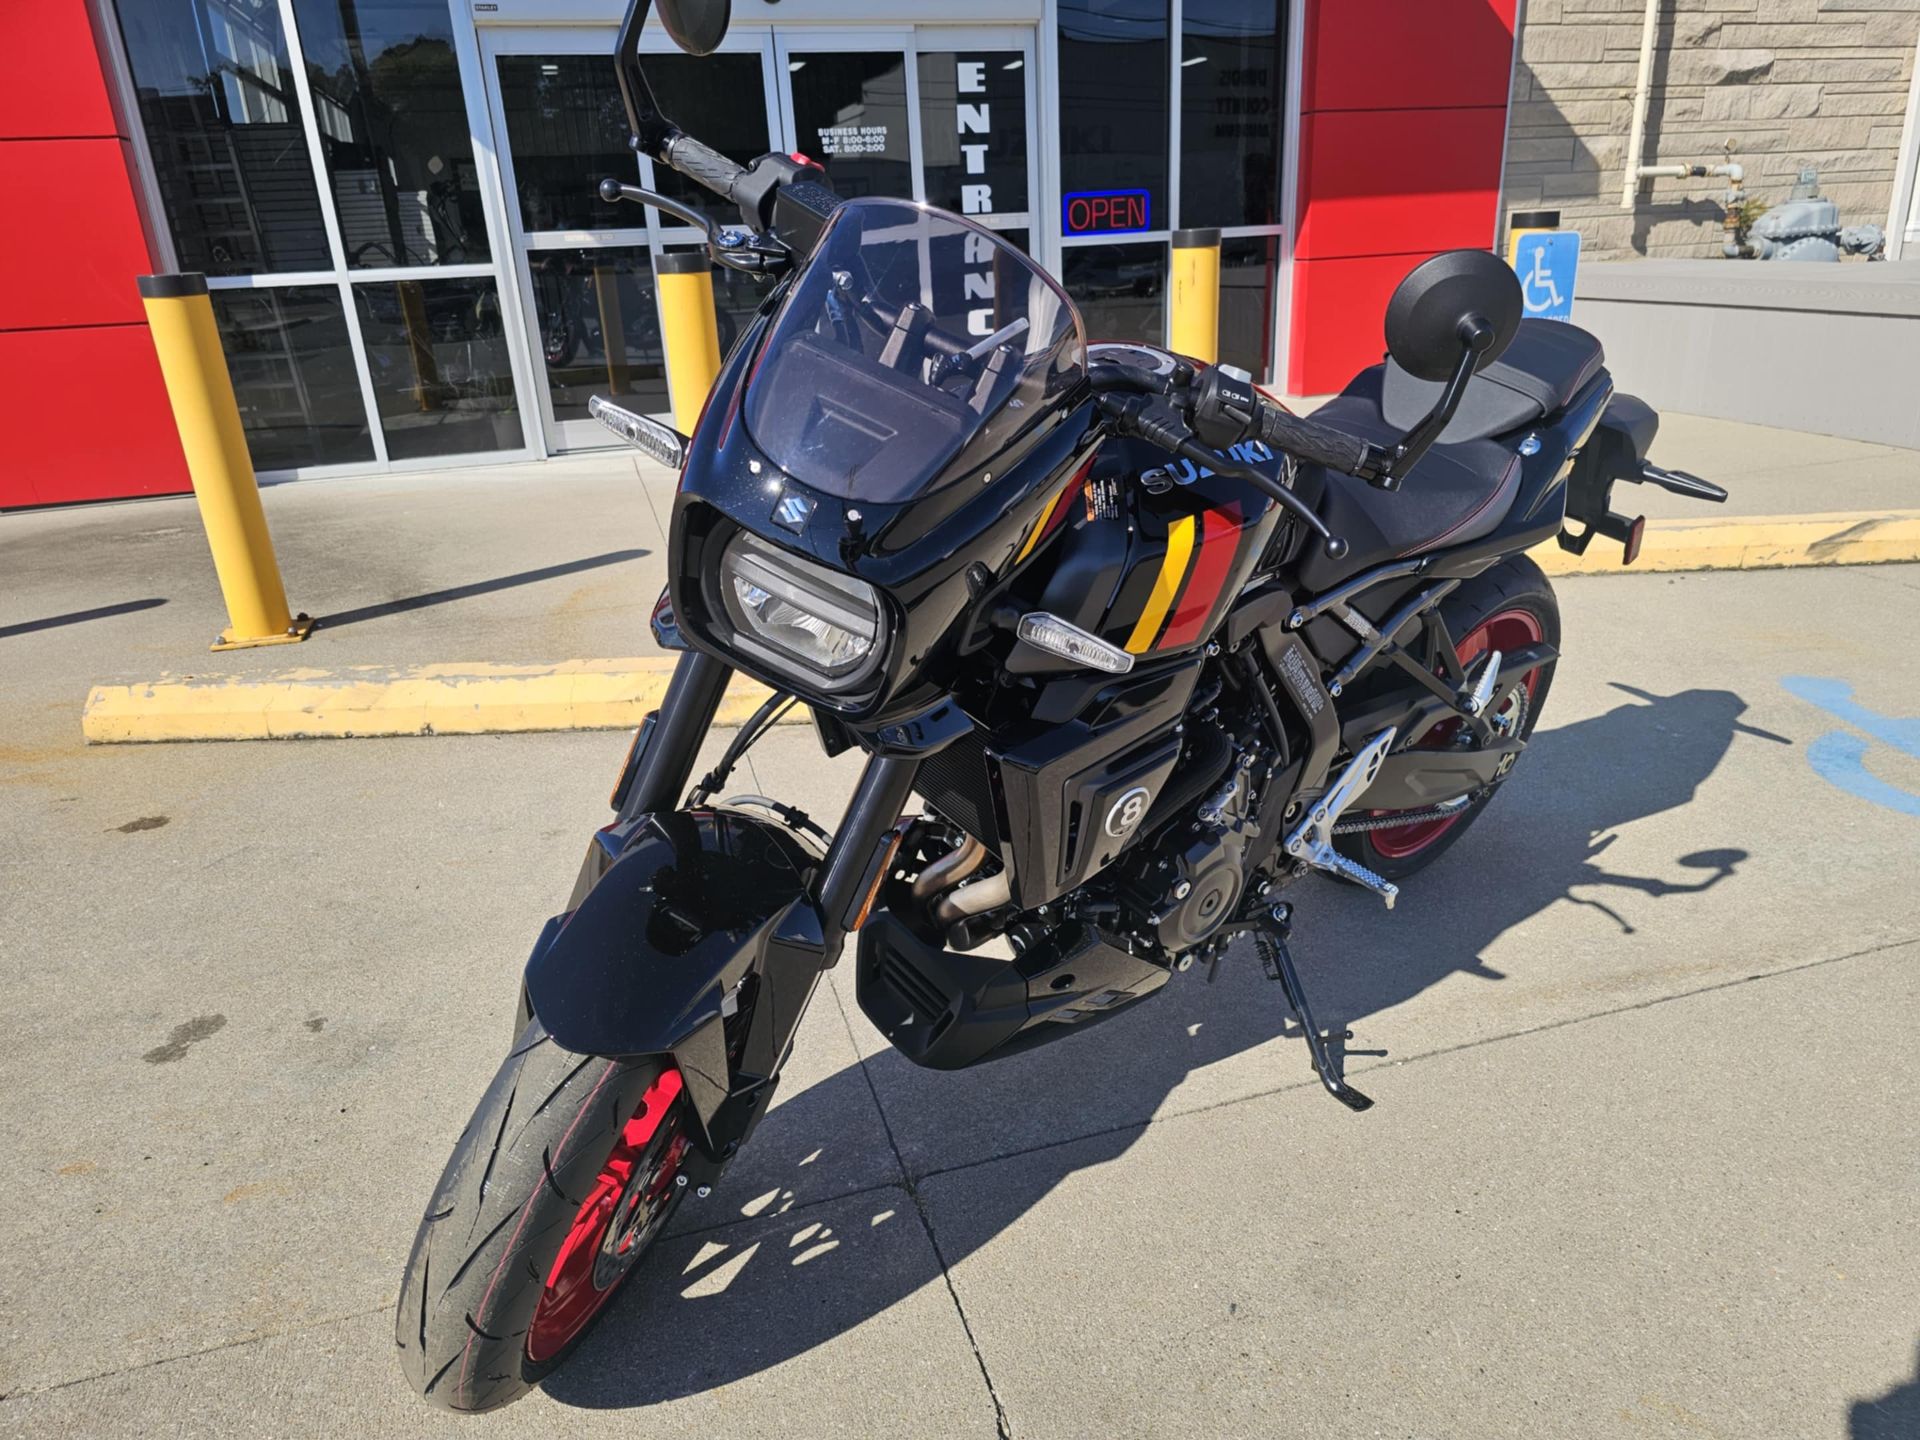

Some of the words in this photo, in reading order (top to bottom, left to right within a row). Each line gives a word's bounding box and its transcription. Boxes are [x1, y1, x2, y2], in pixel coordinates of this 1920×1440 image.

[818, 127, 858, 136] BUSINESS
[860, 126, 887, 135] HOURS
[823, 145, 842, 153] SAT.
[956, 62, 996, 336] ENTRANC
[1068, 196, 1146, 230] OPEN
[1140, 440, 1274, 495] SUKI
